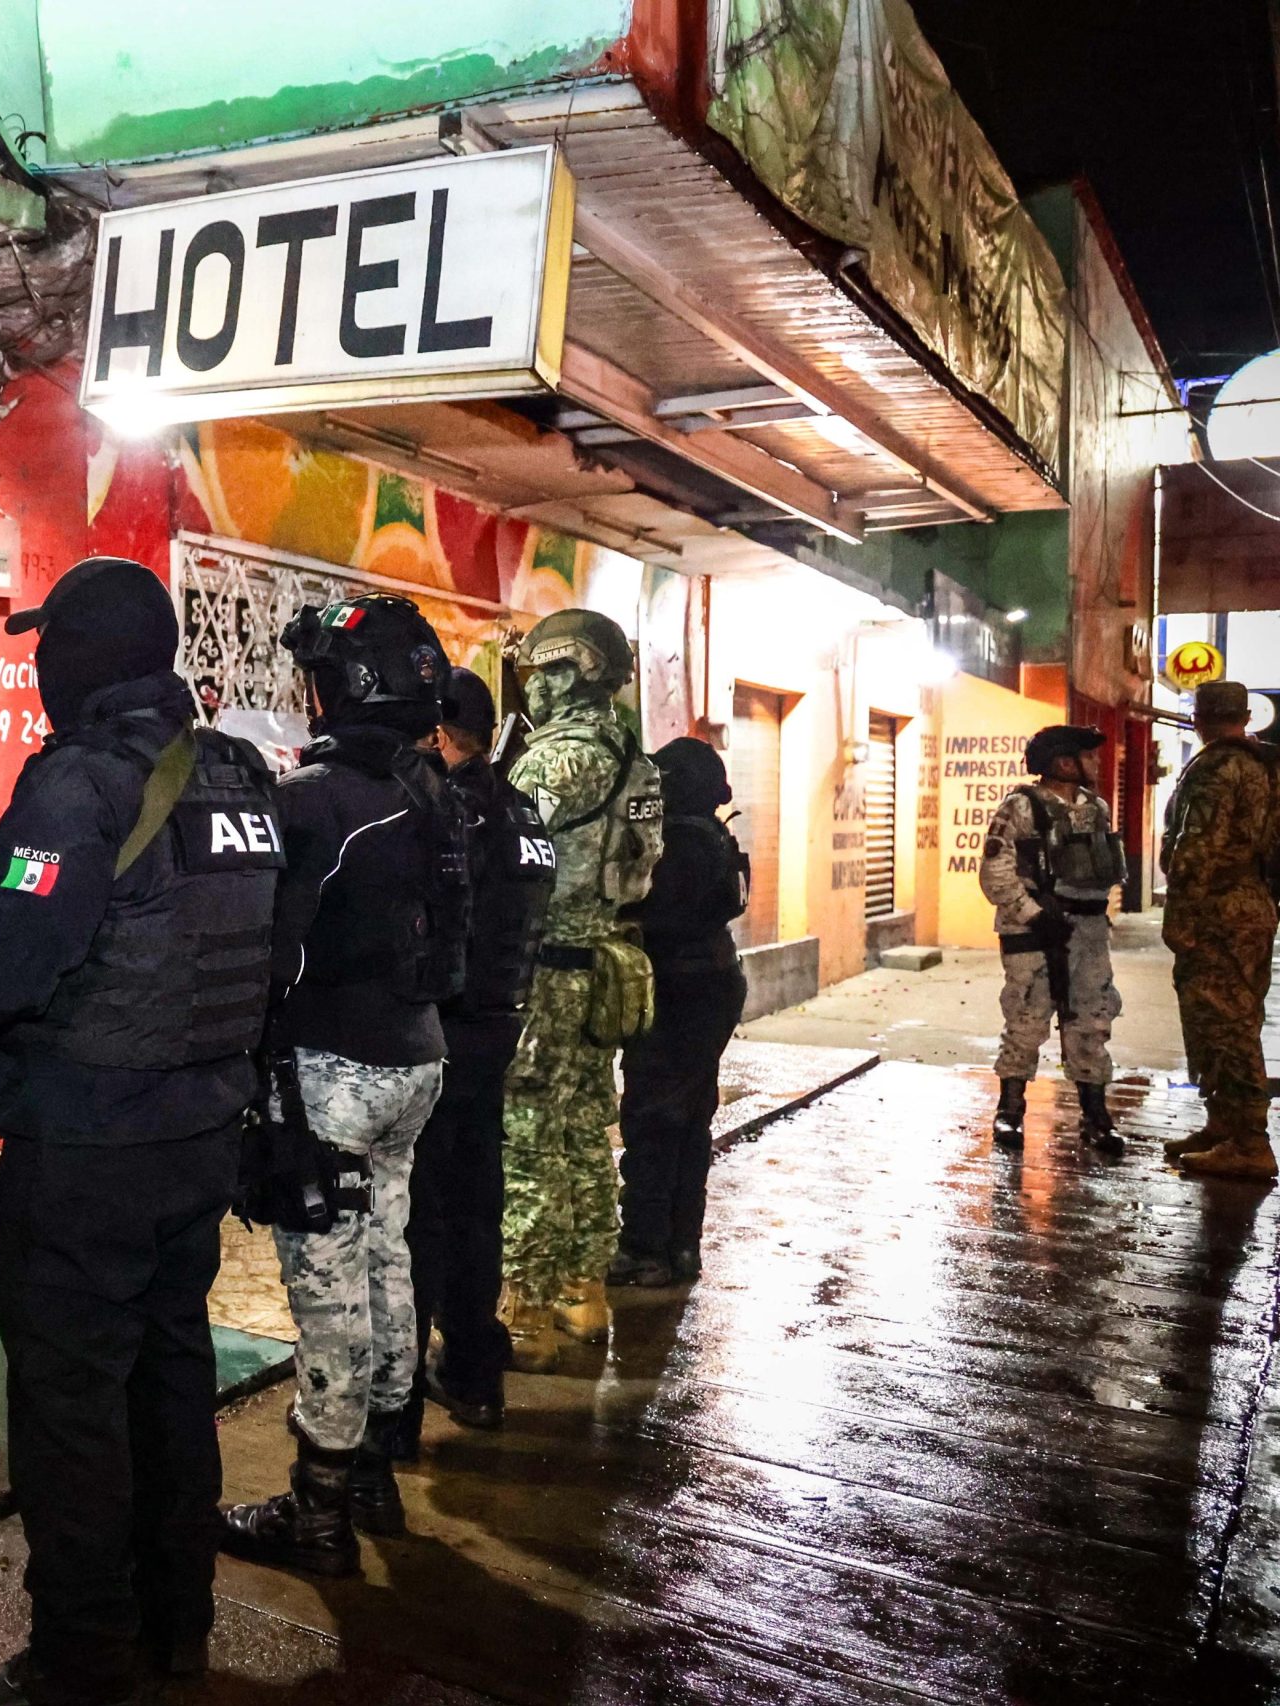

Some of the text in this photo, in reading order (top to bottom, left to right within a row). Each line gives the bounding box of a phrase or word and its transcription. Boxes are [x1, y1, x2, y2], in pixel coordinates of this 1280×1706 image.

[94, 188, 493, 382] HOTEL
[211, 812, 280, 853] AEI
[956, 833, 987, 849] CO
[13, 846, 60, 864] MÉXICO
[520, 836, 556, 868] AEI
[948, 856, 982, 873] MA
